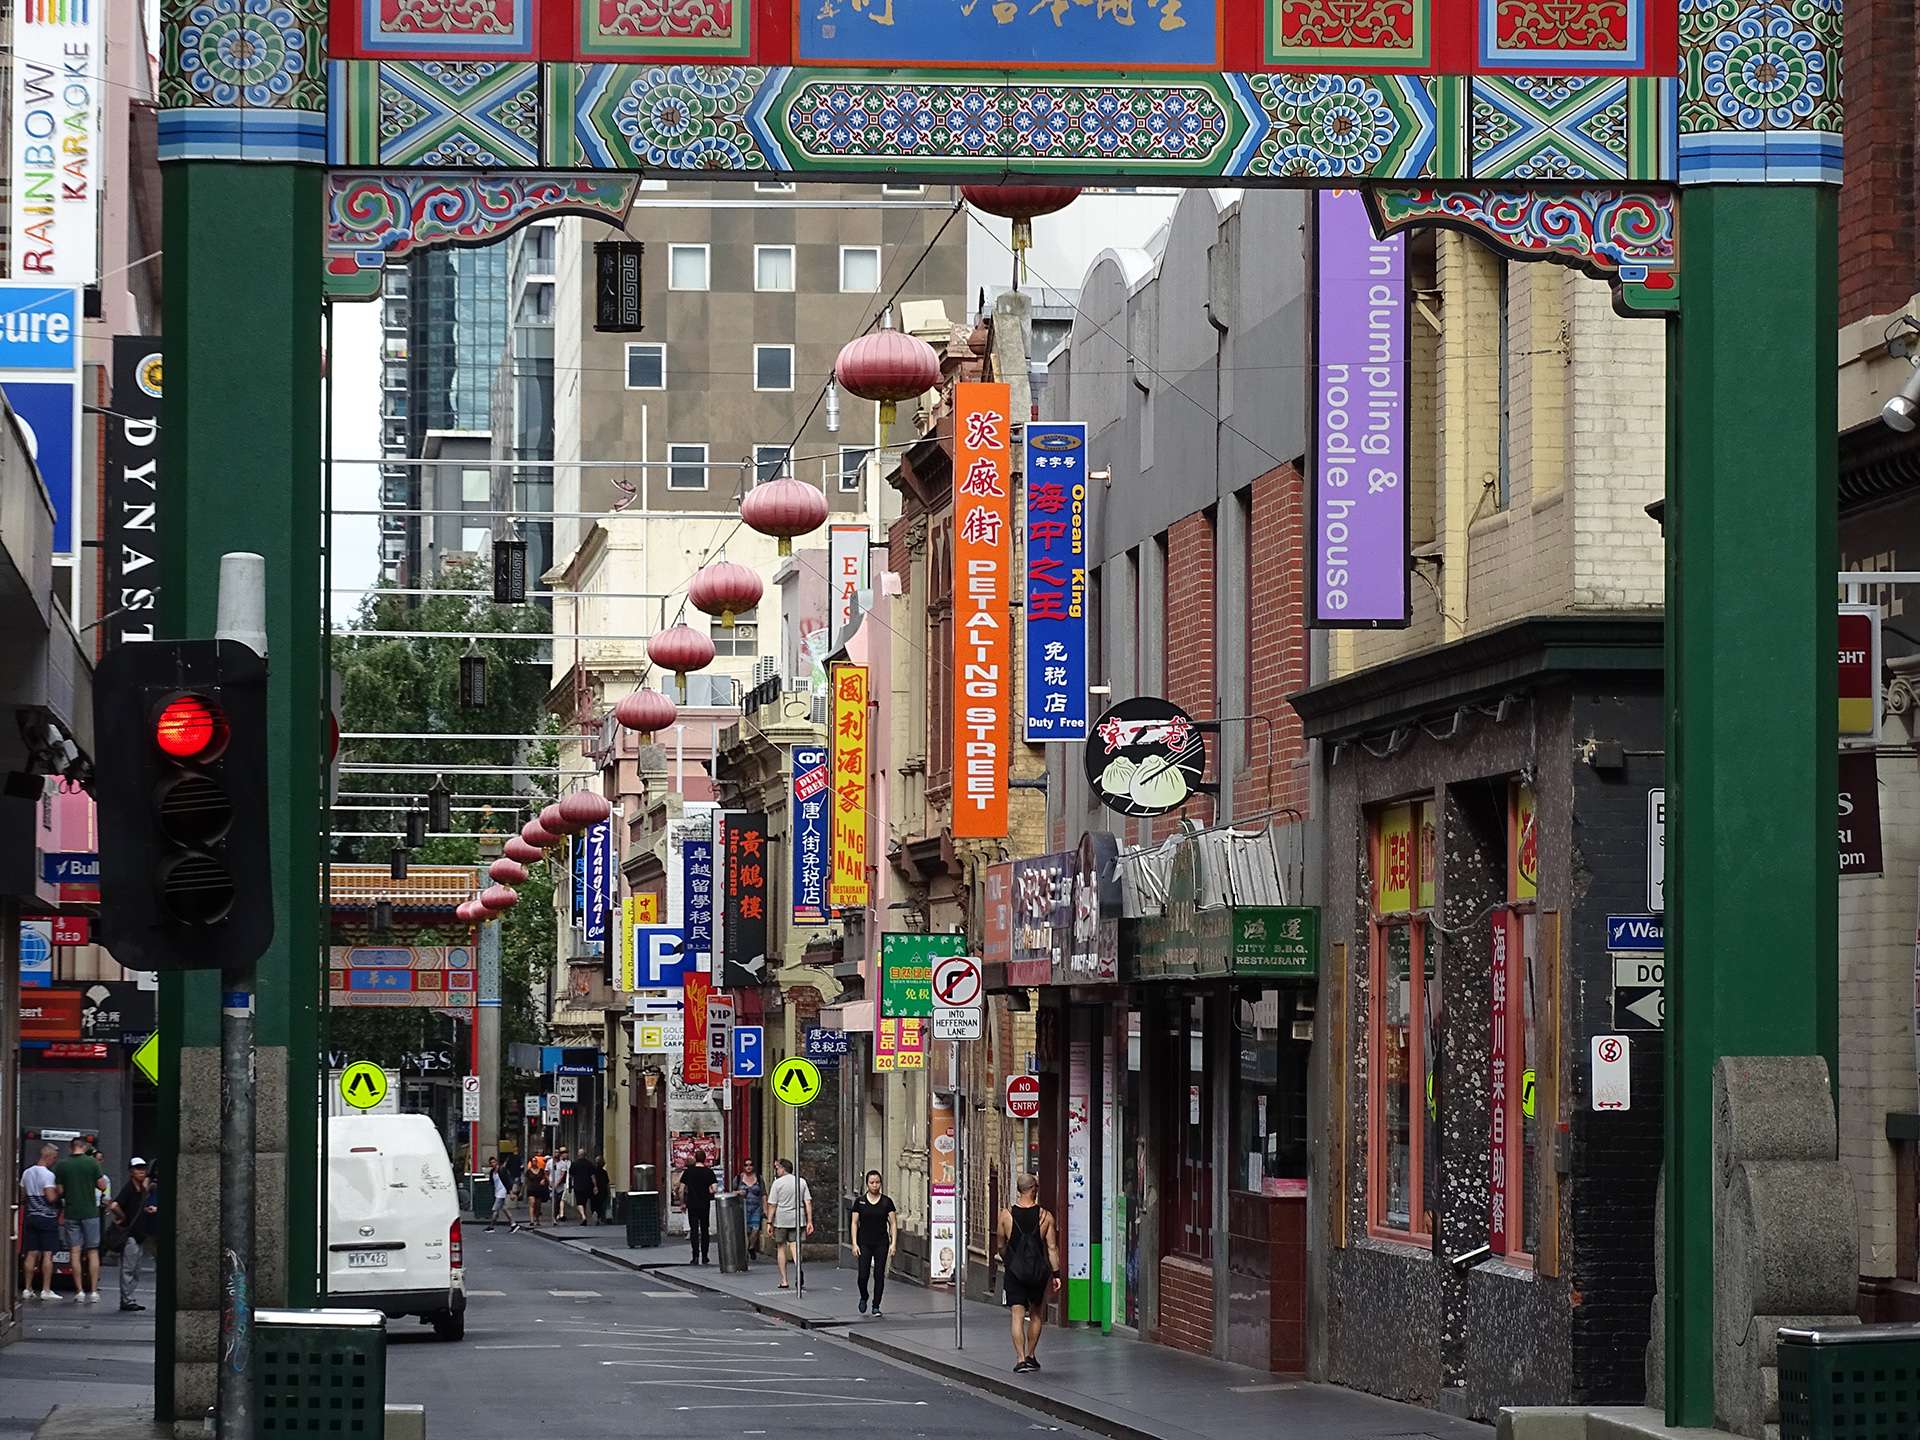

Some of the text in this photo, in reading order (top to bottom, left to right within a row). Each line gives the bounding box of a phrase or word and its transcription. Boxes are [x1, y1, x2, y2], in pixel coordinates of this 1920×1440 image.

[61, 42, 89, 201] KARAOKE
[23, 64, 55, 273] RAINBOW
[1361, 225, 1399, 494] in dumpling &
[1035, 456, 1076, 468] 老字号
[1326, 363, 1356, 611] noodle house
[1028, 483, 1068, 621] 海中之王
[1068, 484, 1085, 618] Ocean King
[965, 559, 999, 810] PETALING STREET
[1044, 641, 1068, 713] 免税店
[1029, 717, 1084, 728] Duty Free
[836, 673, 866, 814] 國利酒家
[799, 767, 825, 787] DUTY
[800, 780, 826, 798] FREE
[836, 818, 863, 855] LING
[729, 828, 739, 896] the crane
[801, 802, 821, 905] 唐人街免税店
[837, 850, 862, 881] NAN
[590, 826, 608, 925] Shanghai
[56, 931, 80, 941] RED
[1236, 944, 1308, 954] CITY B.B.Q.
[650, 935, 684, 981] P
[1235, 956, 1307, 966] RESTAURANT
[710, 1009, 731, 1019] VIP
[935, 1019, 978, 1028] HEFFERNAN
[948, 1010, 965, 1019] INTO
[740, 1033, 757, 1053] P
[947, 1027, 966, 1036] LANE
[1019, 1083, 1031, 1092] NO
[1012, 1101, 1038, 1111] ENTRY
